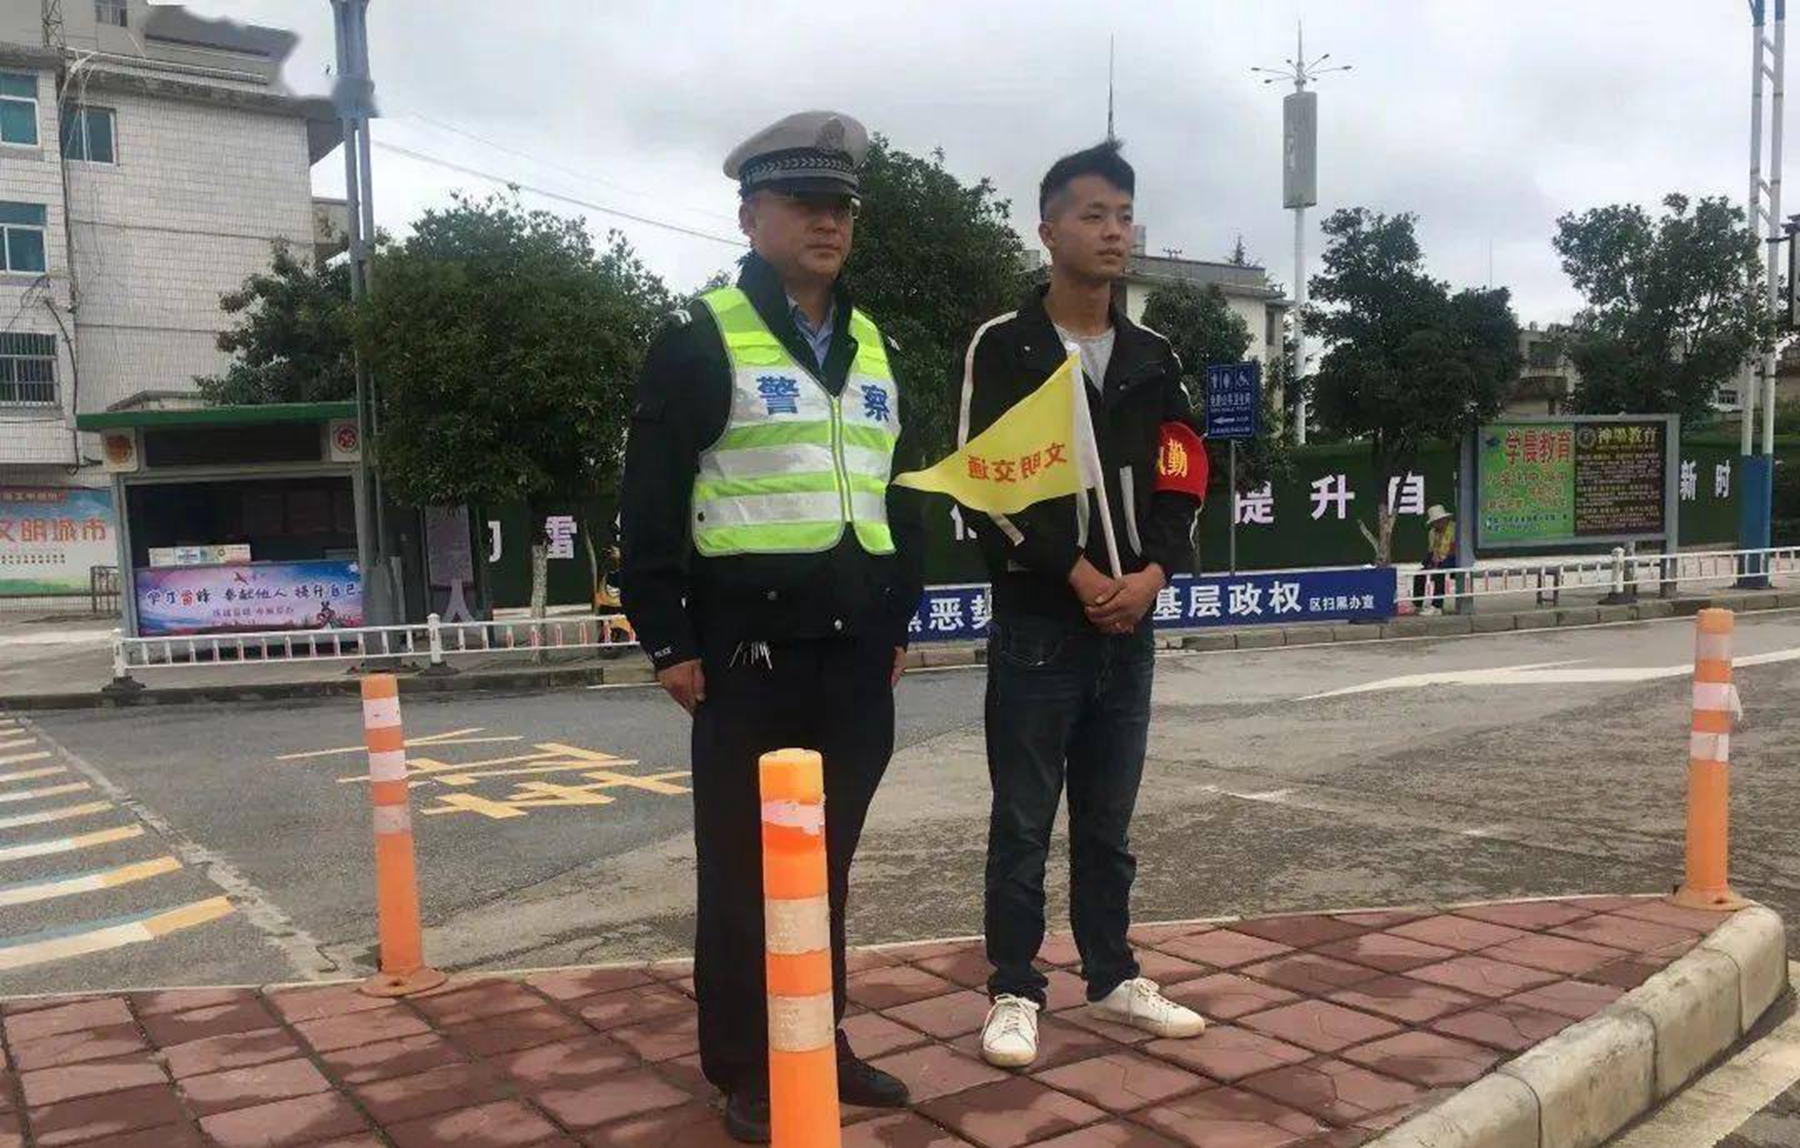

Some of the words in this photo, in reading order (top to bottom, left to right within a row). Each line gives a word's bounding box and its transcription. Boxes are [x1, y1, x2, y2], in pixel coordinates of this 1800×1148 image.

[1156, 437, 1188, 478] 勤
[1152, 580, 1302, 621] 基层政权
